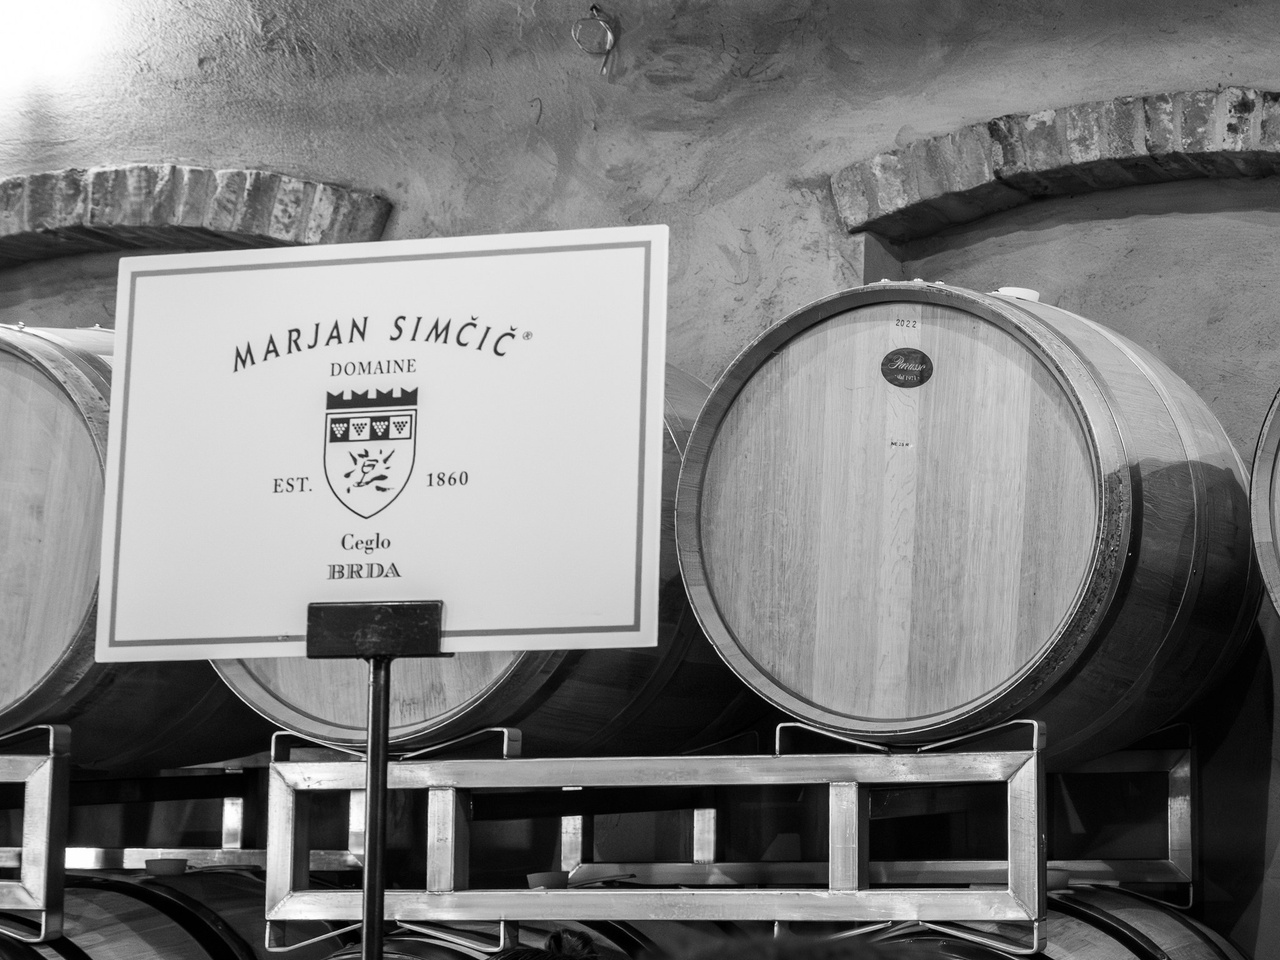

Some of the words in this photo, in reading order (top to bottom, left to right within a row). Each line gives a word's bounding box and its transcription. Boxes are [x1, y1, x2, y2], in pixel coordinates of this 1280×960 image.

[895, 319, 917, 328] 2022
[233, 316, 369, 373] MARJAN
[330, 358, 417, 377] DOMAINE
[273, 476, 313, 494] EST.
[426, 470, 469, 488] 1860
[340, 532, 392, 555] Ceglo
[327, 562, 402, 580] BRDA
